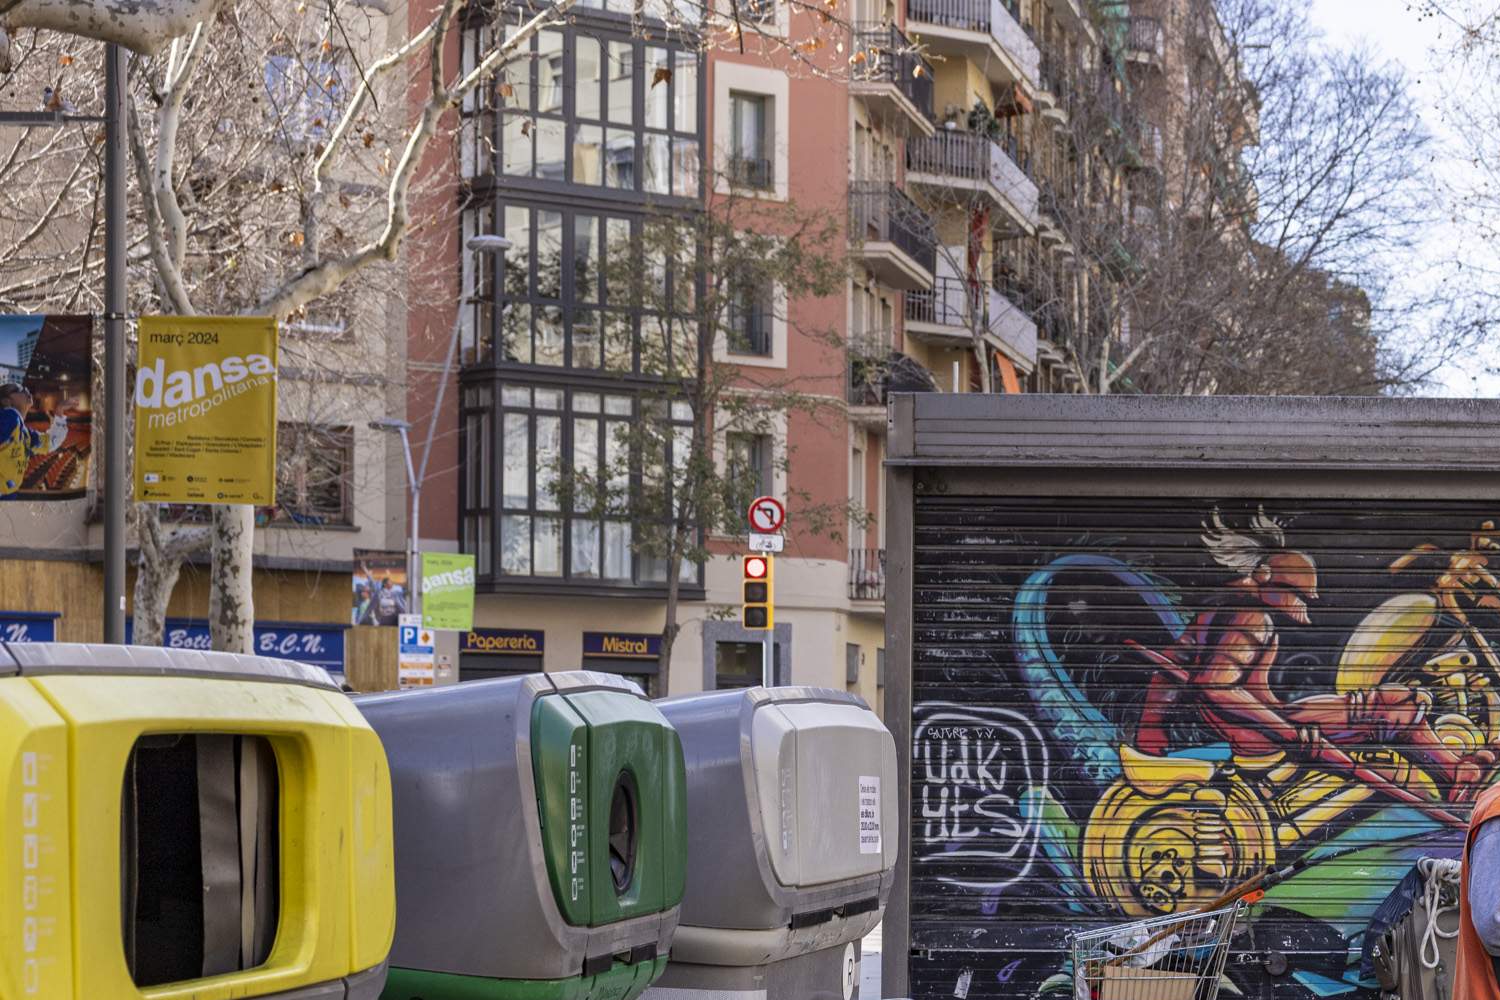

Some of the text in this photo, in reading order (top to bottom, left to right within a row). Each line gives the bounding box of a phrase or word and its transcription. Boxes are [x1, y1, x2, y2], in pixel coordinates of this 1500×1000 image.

[149, 332, 219, 346] març 2024
[148, 374, 269, 429] metropolitana
[259, 633, 326, 655] B.C.N.
[403, 627, 415, 644] P
[602, 636, 648, 653] Mistral
